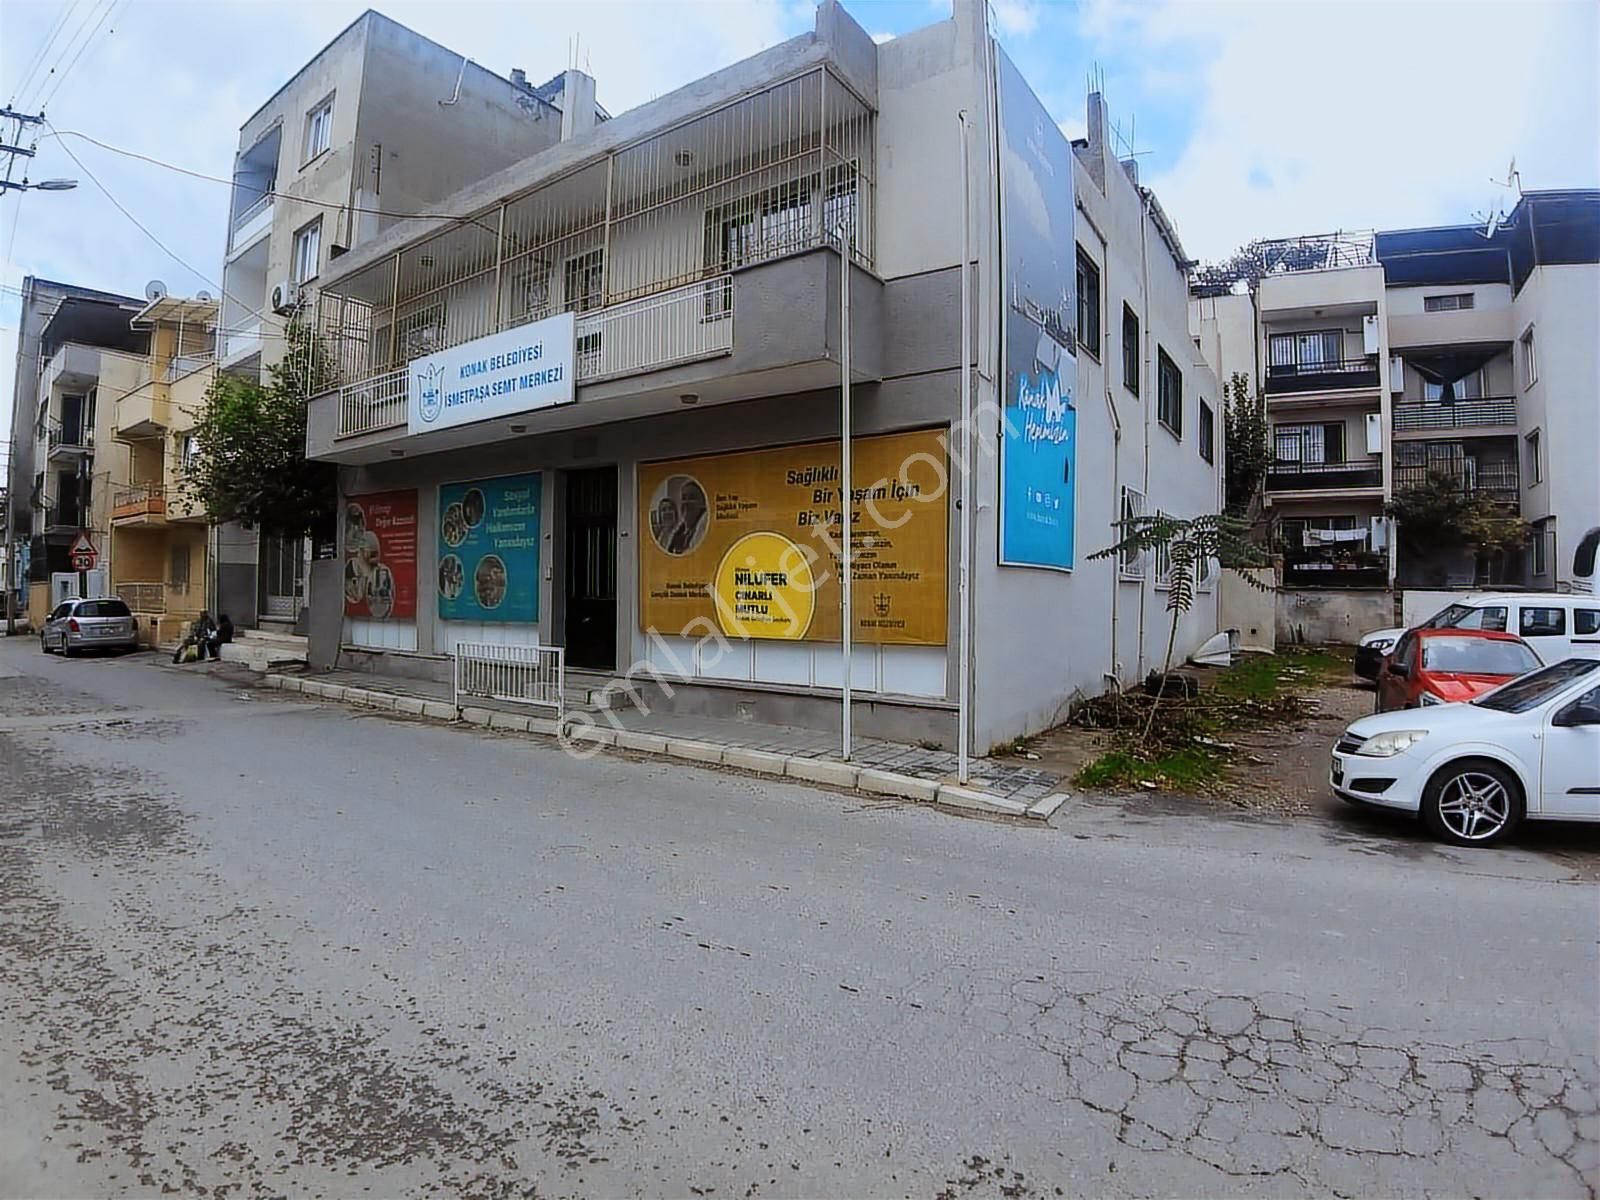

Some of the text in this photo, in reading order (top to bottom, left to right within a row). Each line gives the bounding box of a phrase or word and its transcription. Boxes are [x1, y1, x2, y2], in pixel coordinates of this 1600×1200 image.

[459, 341, 543, 379] KONAK BELEDİYESİ
[444, 363, 564, 408] İSMETPAŞA SEMT MERKEZİ
[787, 465, 838, 486] Sağlıklı
[813, 487, 834, 503] Bir
[891, 479, 920, 502] İçin
[798, 510, 819, 526] Biz
[76, 558, 90, 567] 30
[735, 604, 769, 614] MUTLU
